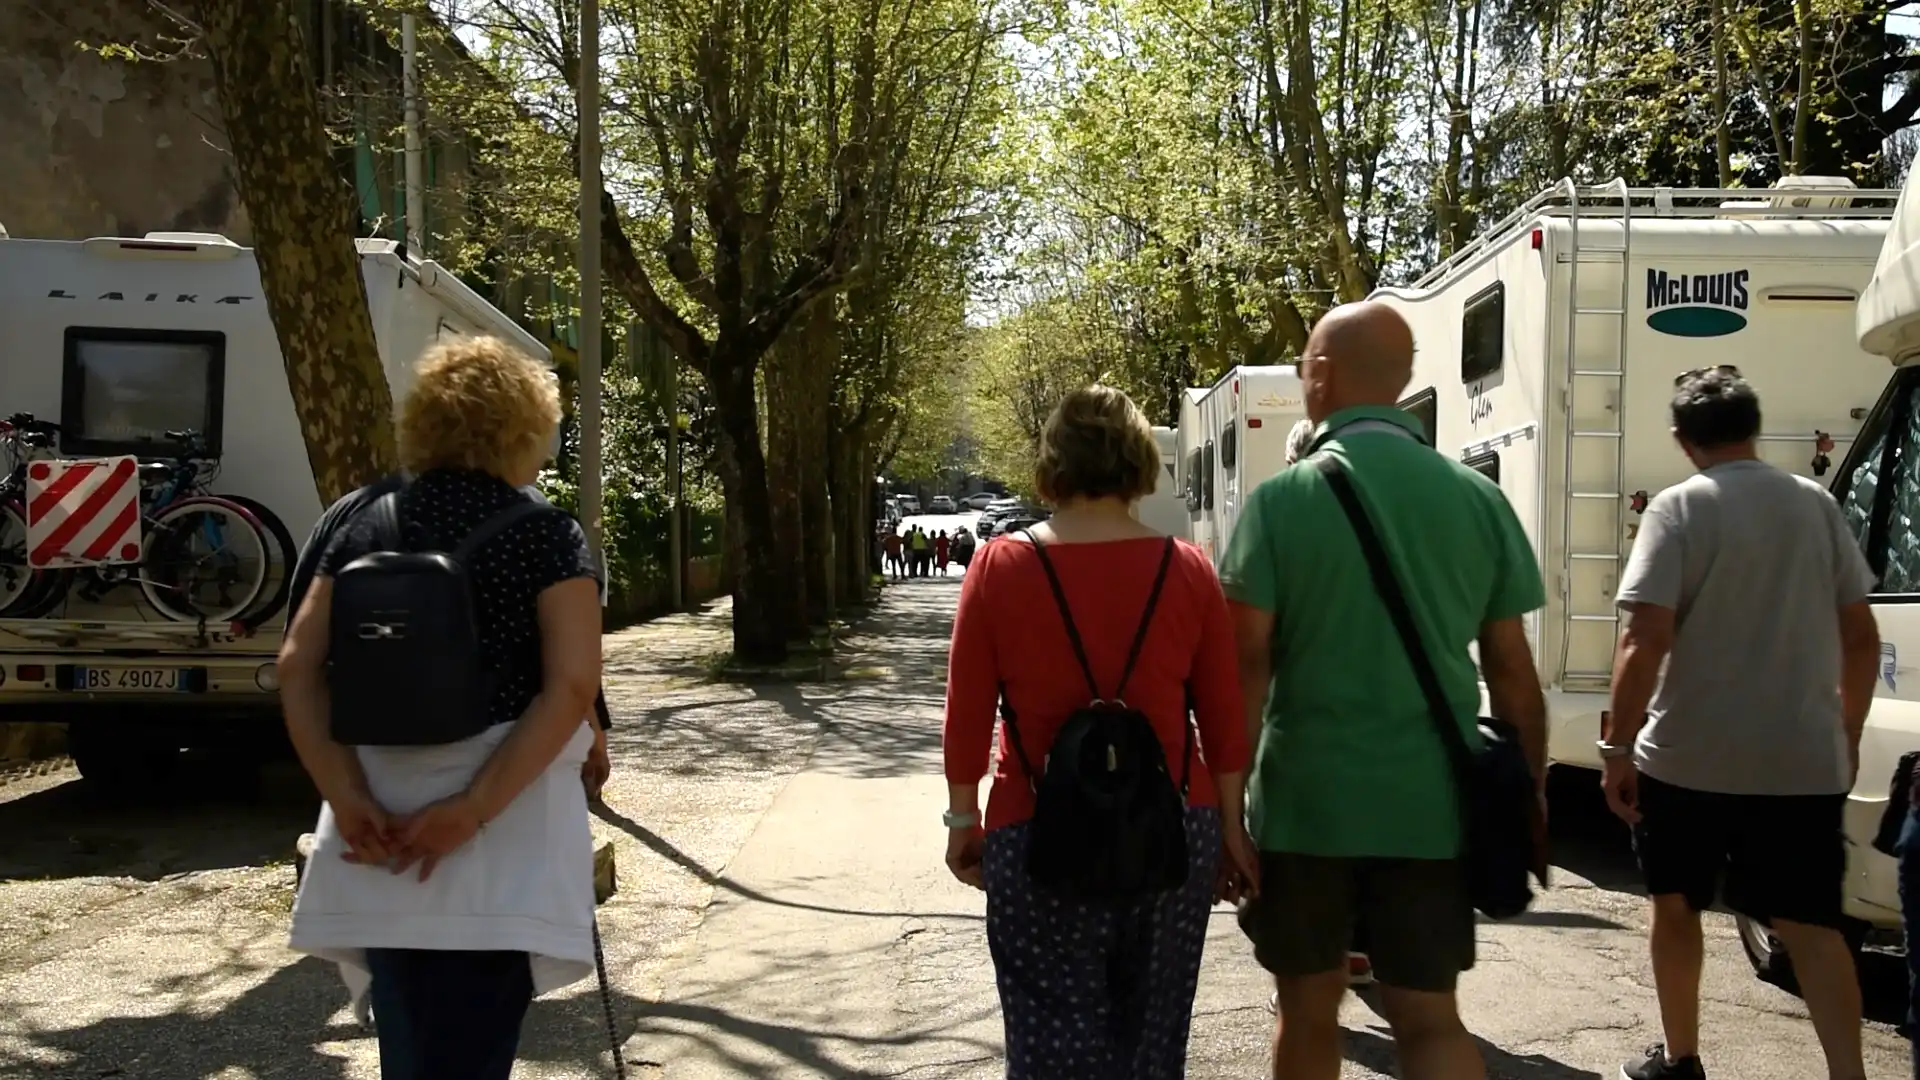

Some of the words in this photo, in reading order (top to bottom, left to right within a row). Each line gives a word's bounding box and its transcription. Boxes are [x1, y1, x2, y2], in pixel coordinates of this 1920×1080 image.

[47, 289, 254, 305] LAIKA
[88, 669, 111, 688] BS
[118, 669, 176, 689] 490ZJ
